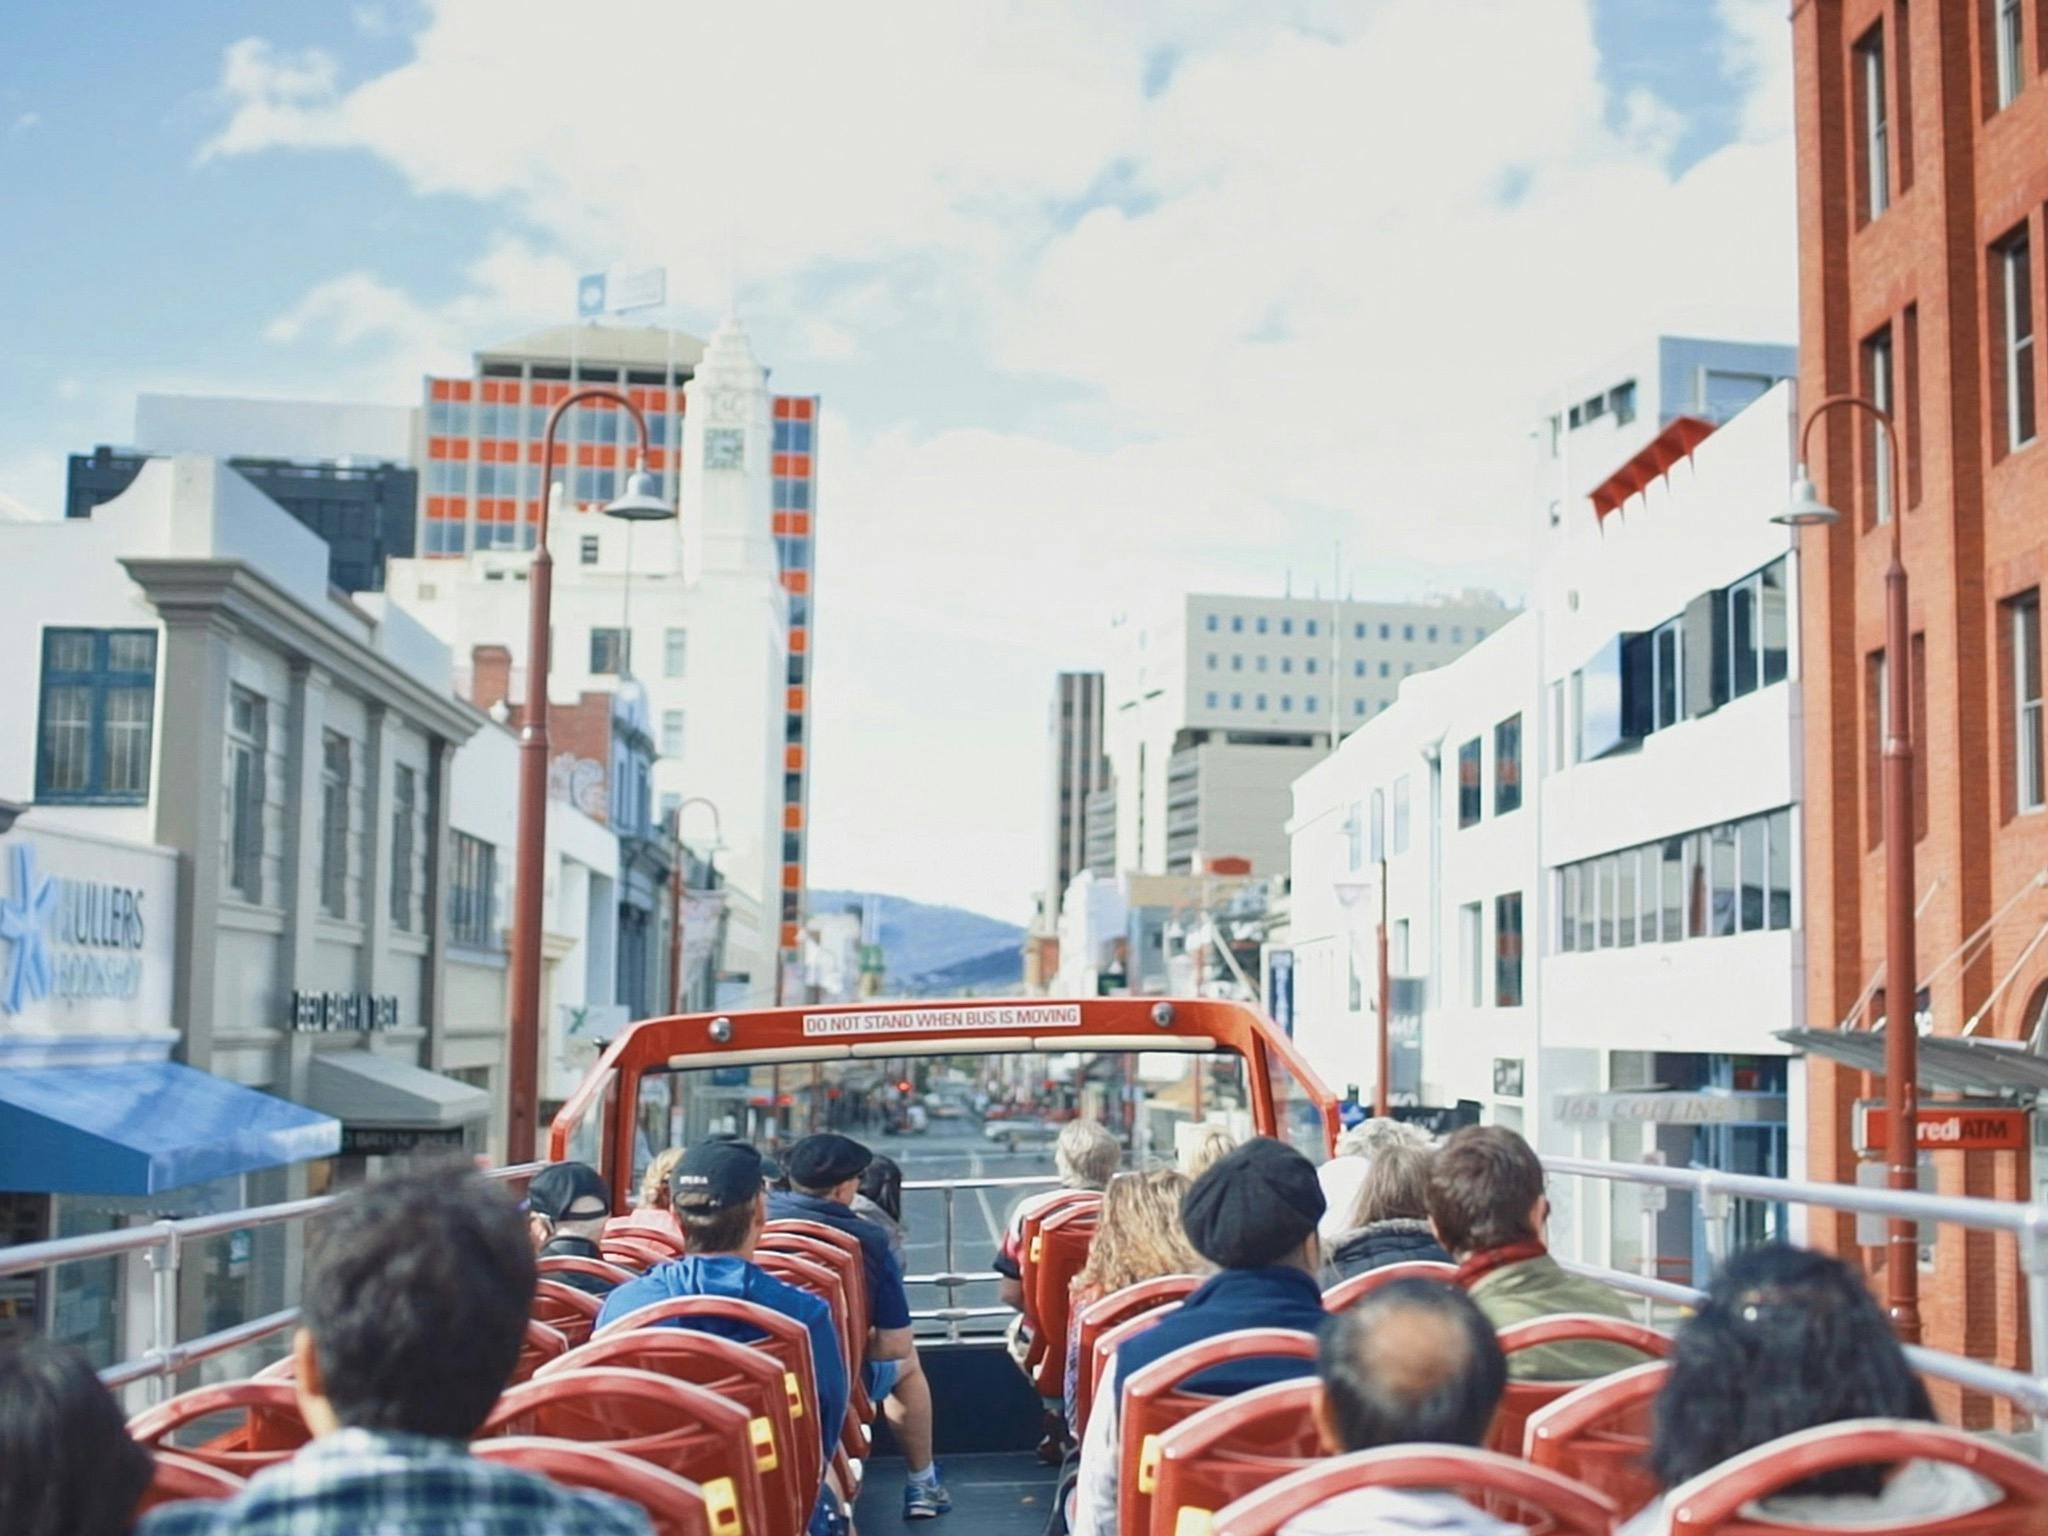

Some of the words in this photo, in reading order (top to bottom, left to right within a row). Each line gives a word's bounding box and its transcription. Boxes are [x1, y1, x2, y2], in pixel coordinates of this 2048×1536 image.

[806, 1018, 827, 1033] DO
[830, 1016, 861, 1031] NOT
[863, 1013, 913, 1030] STAND
[916, 1011, 963, 1028] WHEN
[966, 1011, 997, 1026] BUS
[1000, 1010, 1013, 1024] IS
[1016, 1008, 1077, 1024] MOVING
